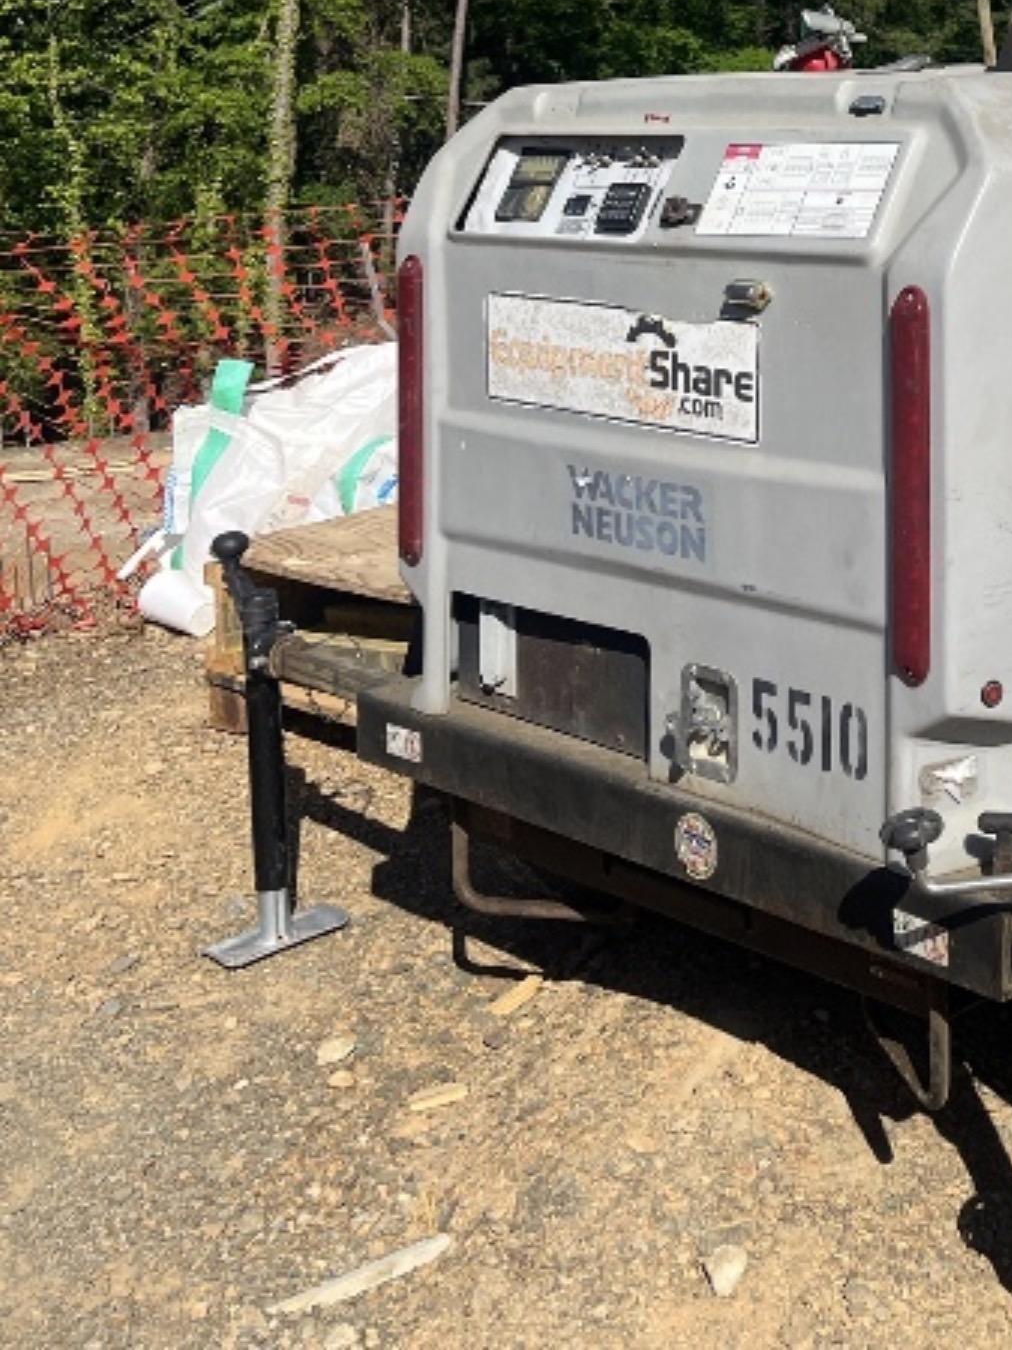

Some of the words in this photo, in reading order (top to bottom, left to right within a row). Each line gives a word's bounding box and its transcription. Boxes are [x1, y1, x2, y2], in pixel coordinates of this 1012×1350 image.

[678, 396, 723, 420] .com
[566, 464, 705, 524] WACKER
[571, 502, 706, 564] NEUSON
[752, 677, 868, 781] 5510
